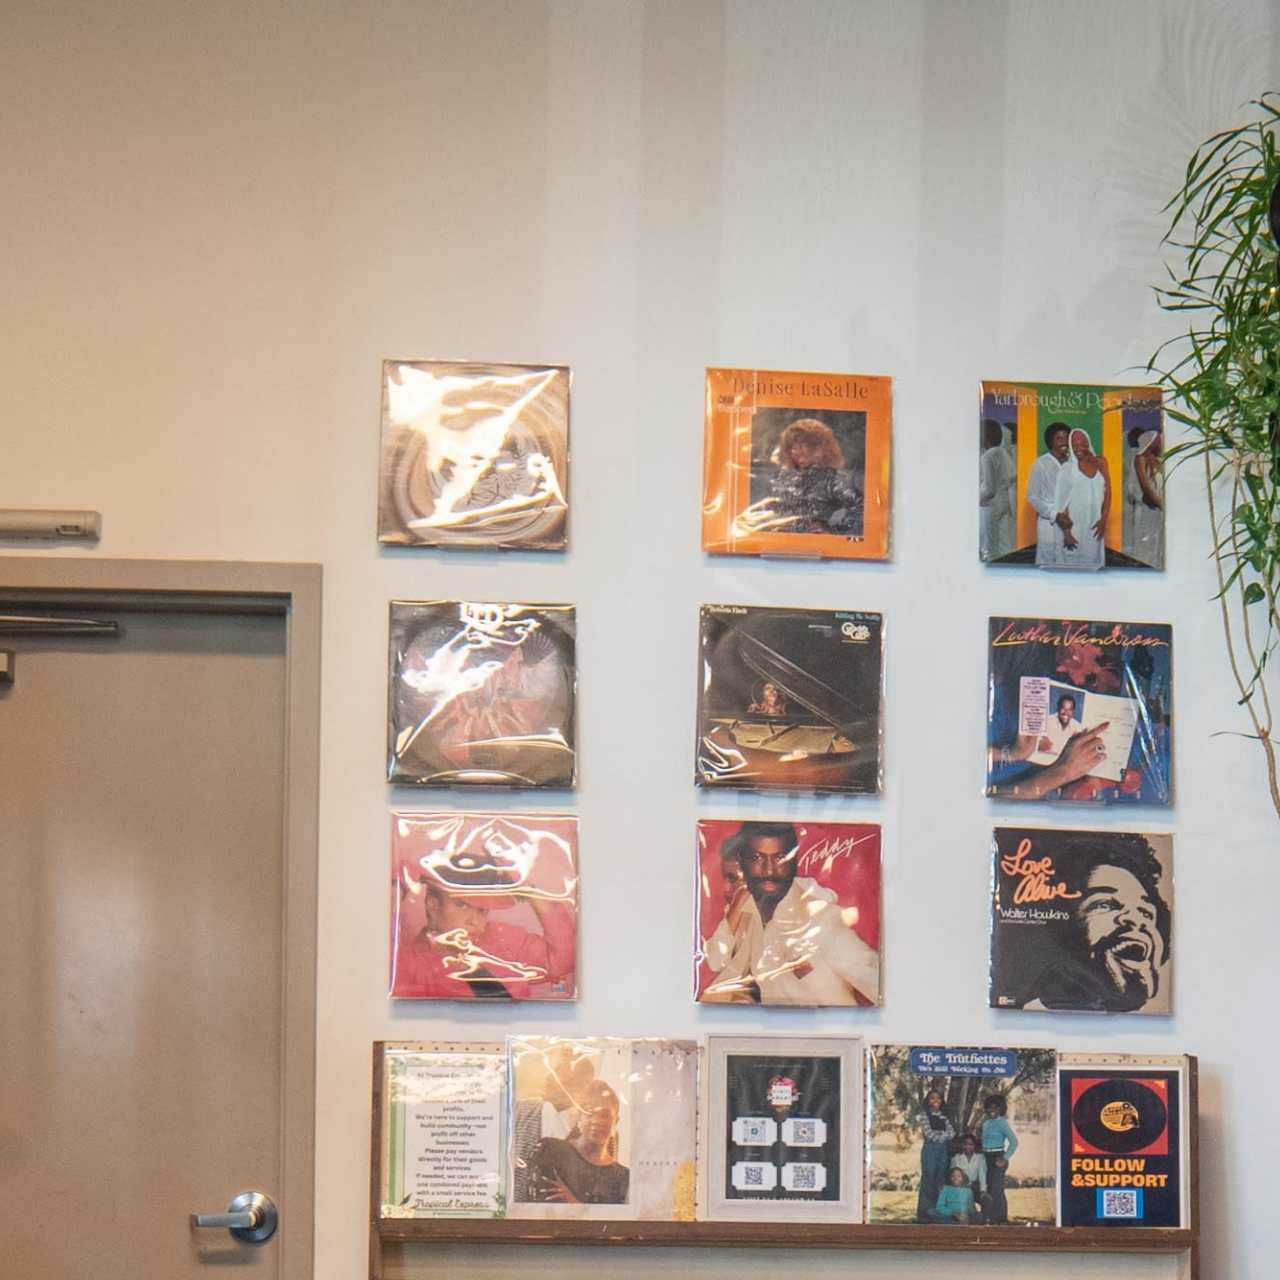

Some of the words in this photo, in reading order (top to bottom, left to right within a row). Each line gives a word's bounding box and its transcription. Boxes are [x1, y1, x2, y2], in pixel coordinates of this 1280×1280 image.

[733, 377, 794, 396] Denise
[801, 380, 870, 399] LaSalle
[798, 833, 877, 875] Teddy
[1001, 838, 1055, 876] Love
[1001, 908, 1029, 919] Walter
[1030, 909, 1070, 920] Hawkins
[920, 1052, 940, 1065] The
[945, 1053, 1008, 1065] Truthettes
[1071, 1158, 1146, 1172] FOLLOW
[1071, 1173, 1169, 1187] &SUPPORT
